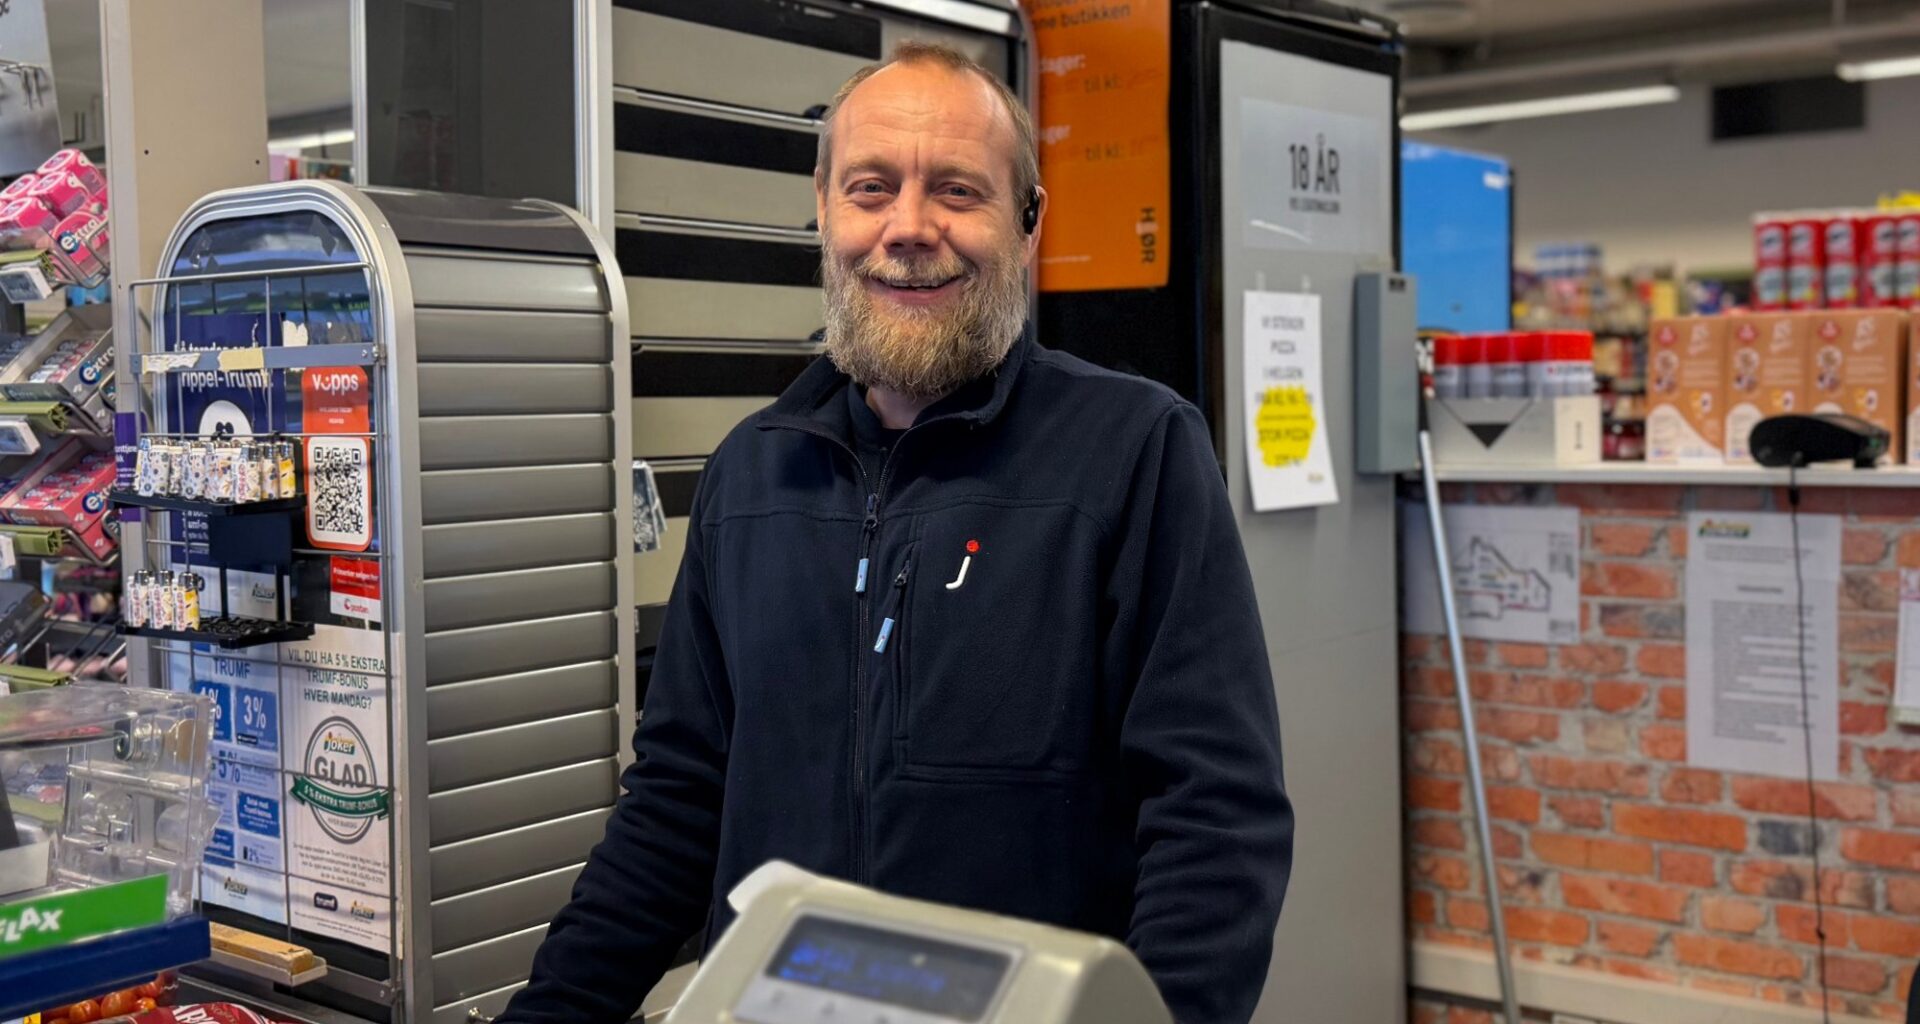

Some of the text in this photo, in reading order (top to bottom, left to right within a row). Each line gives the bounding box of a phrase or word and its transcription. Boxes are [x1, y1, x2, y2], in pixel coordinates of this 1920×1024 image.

[1289, 132, 1341, 194] 18 ÅR
[61, 216, 99, 250] extra
[213, 657, 251, 679] TRUMF
[288, 648, 302, 662] VIL
[305, 649, 318, 664] DU
[321, 651, 334, 665] HA
[351, 657, 386, 672] EKSTRA
[307, 668, 369, 690] TRUMF-BONUS
[243, 695, 267, 729] 3%
[304, 688, 373, 710] HVER MANDAG?
[314, 755, 367, 788] GLAD
